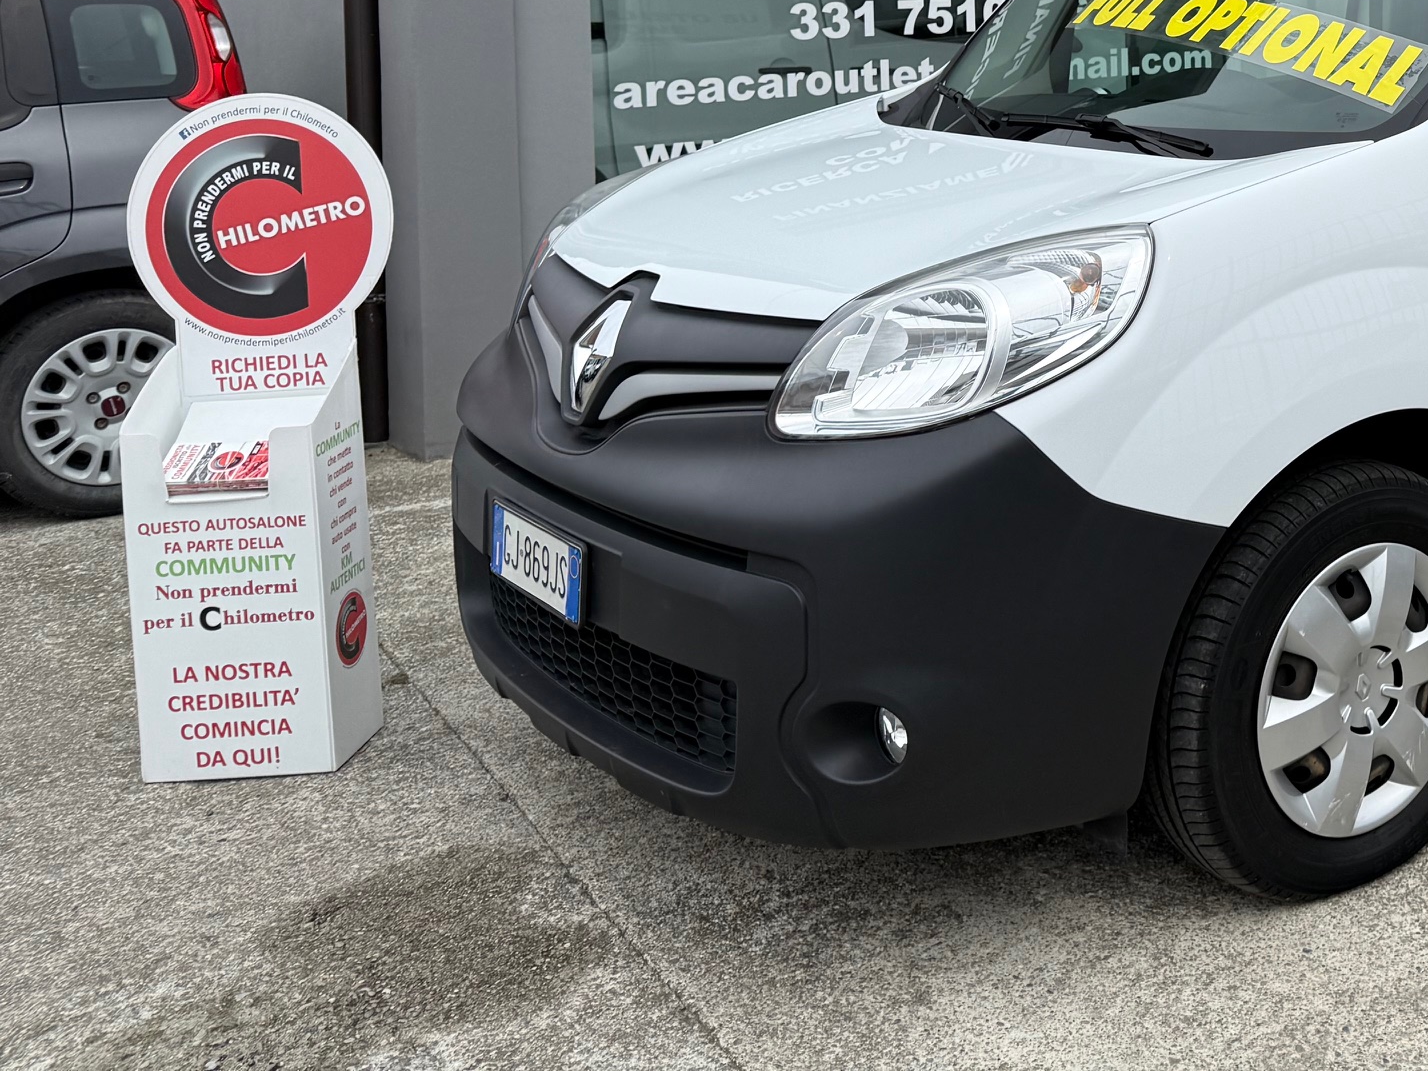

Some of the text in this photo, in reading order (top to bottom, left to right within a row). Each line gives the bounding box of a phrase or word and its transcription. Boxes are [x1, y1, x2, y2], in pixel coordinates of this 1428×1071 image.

[789, 0, 876, 41] 331
[189, 105, 339, 139] Non prendermi per il Chilometro
[193, 161, 296, 263] NON PRENDERMI PER IL
[184, 307, 346, 347] www.nonprendermiperilchilometro.it
[211, 352, 328, 375] RICHIEDI LA
[216, 371, 325, 393] TUA COPIA
[316, 420, 360, 457] COMMUNITY
[137, 514, 307, 536] QUESTO AUTOSALONE
[164, 536, 284, 554] FA PARTE DELLA
[155, 553, 296, 578] COMMUNITY
[341, 551, 352, 570] KM
[504, 524, 567, 599] GJ869JS
[330, 557, 365, 594] AUTENTICI
[155, 579, 298, 603] Non prendermi
[143, 606, 315, 635] per il Chilometro
[172, 661, 292, 684] LA NOSTRA
[168, 687, 301, 713] CREDIBILITA'
[180, 718, 293, 740] COMINCIA
[196, 746, 281, 769] DA QUI!
